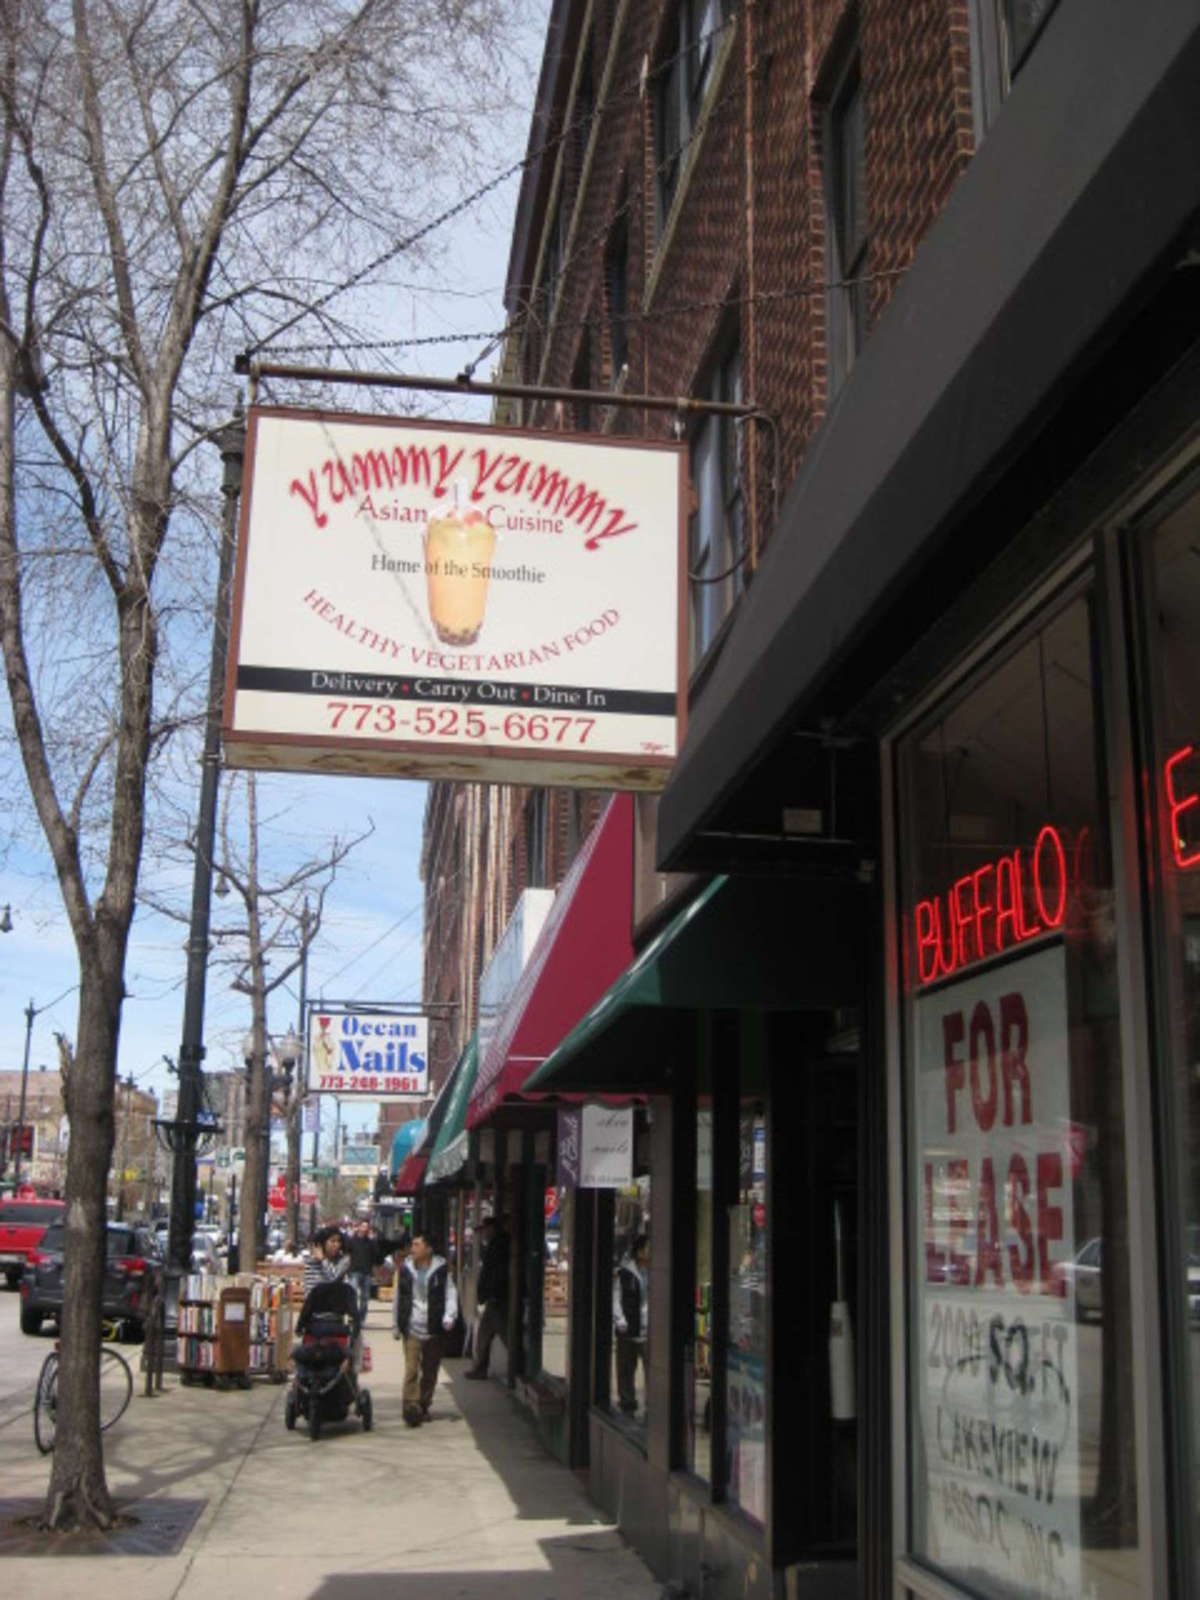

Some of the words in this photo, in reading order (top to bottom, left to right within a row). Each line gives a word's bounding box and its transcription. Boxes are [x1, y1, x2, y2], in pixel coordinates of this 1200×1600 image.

[355, 494, 428, 522] Asian
[486, 504, 564, 534] Cuisine
[424, 558, 441, 576] of
[444, 559, 467, 577] the
[472, 561, 546, 584] Smoothie
[304, 589, 404, 658] HEALTHY
[411, 641, 561, 671] VEGETARIAN
[563, 608, 620, 651] FOOD
[311, 672, 399, 699] Delivery
[414, 679, 472, 704] Carry
[477, 681, 517, 701] Out
[534, 686, 581, 704] Dine
[586, 689, 607, 707] In
[327, 702, 596, 744] 773-525-6677
[914, 825, 1067, 984] BUFFALO
[341, 1016, 417, 1037] Ocean
[338, 1040, 426, 1073] Nails
[942, 992, 1033, 1135] FOR
[924, 1152, 1067, 1299] LEASE
[936, 1405, 1059, 1505] LAKEVIEW
